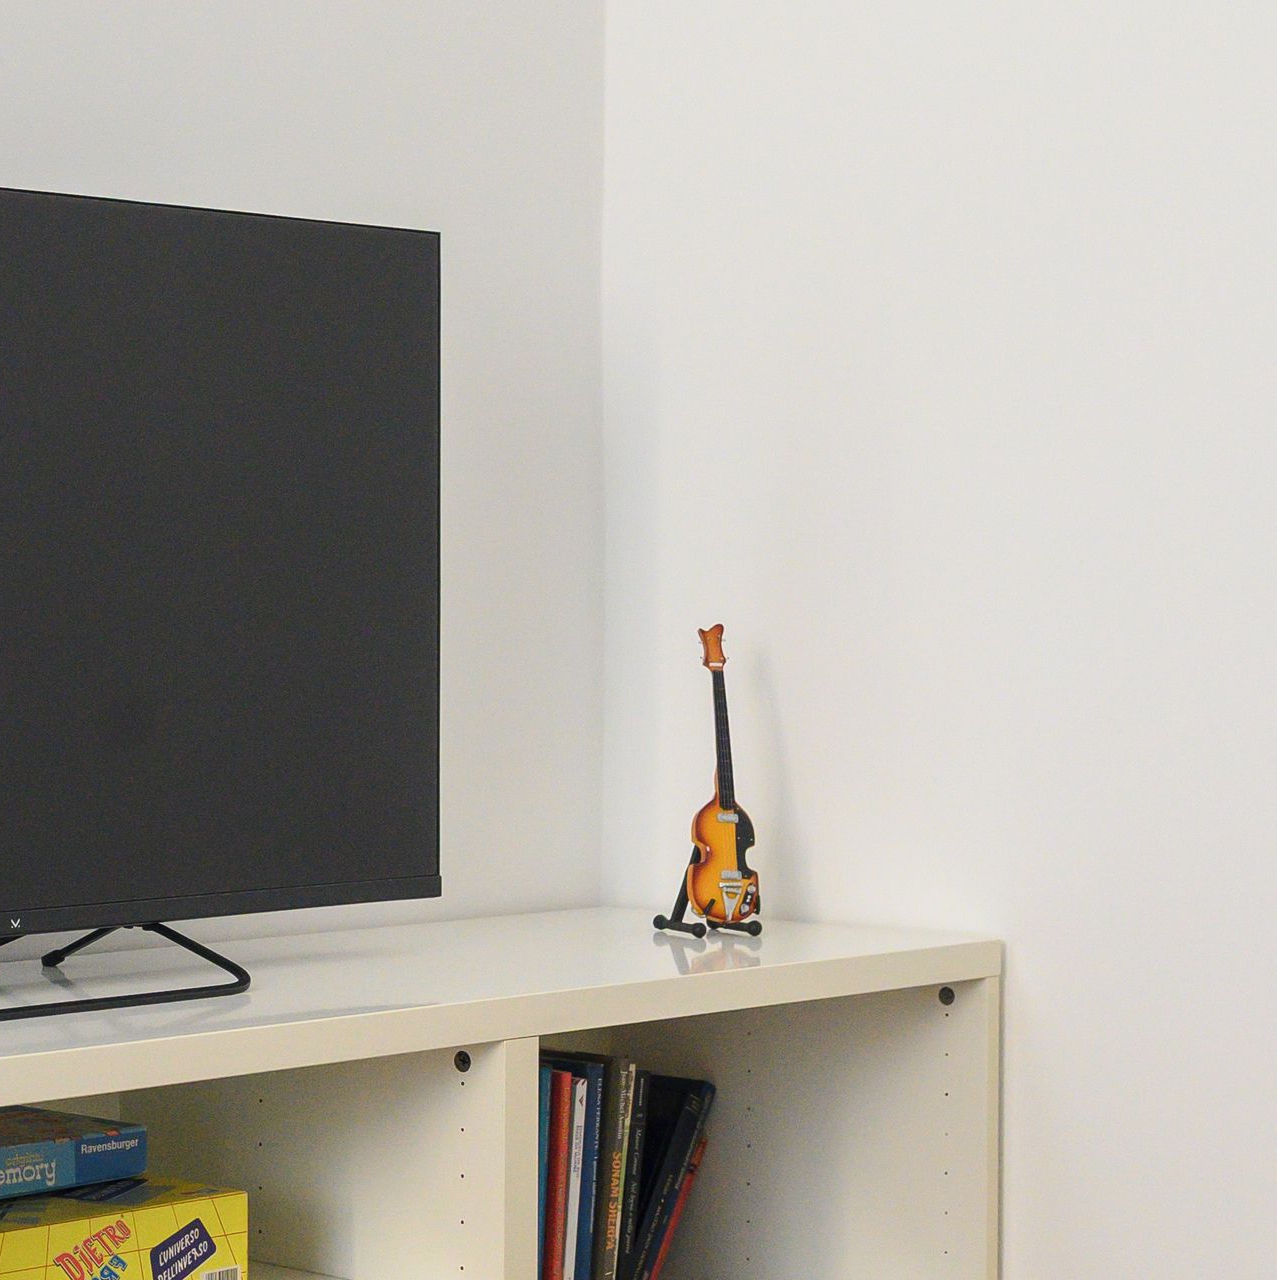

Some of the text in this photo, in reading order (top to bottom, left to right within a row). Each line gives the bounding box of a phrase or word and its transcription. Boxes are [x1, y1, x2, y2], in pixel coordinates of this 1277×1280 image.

[81, 1137, 139, 1154] Ravensburger
[606, 1152, 621, 1250] SONAM SHERPA
